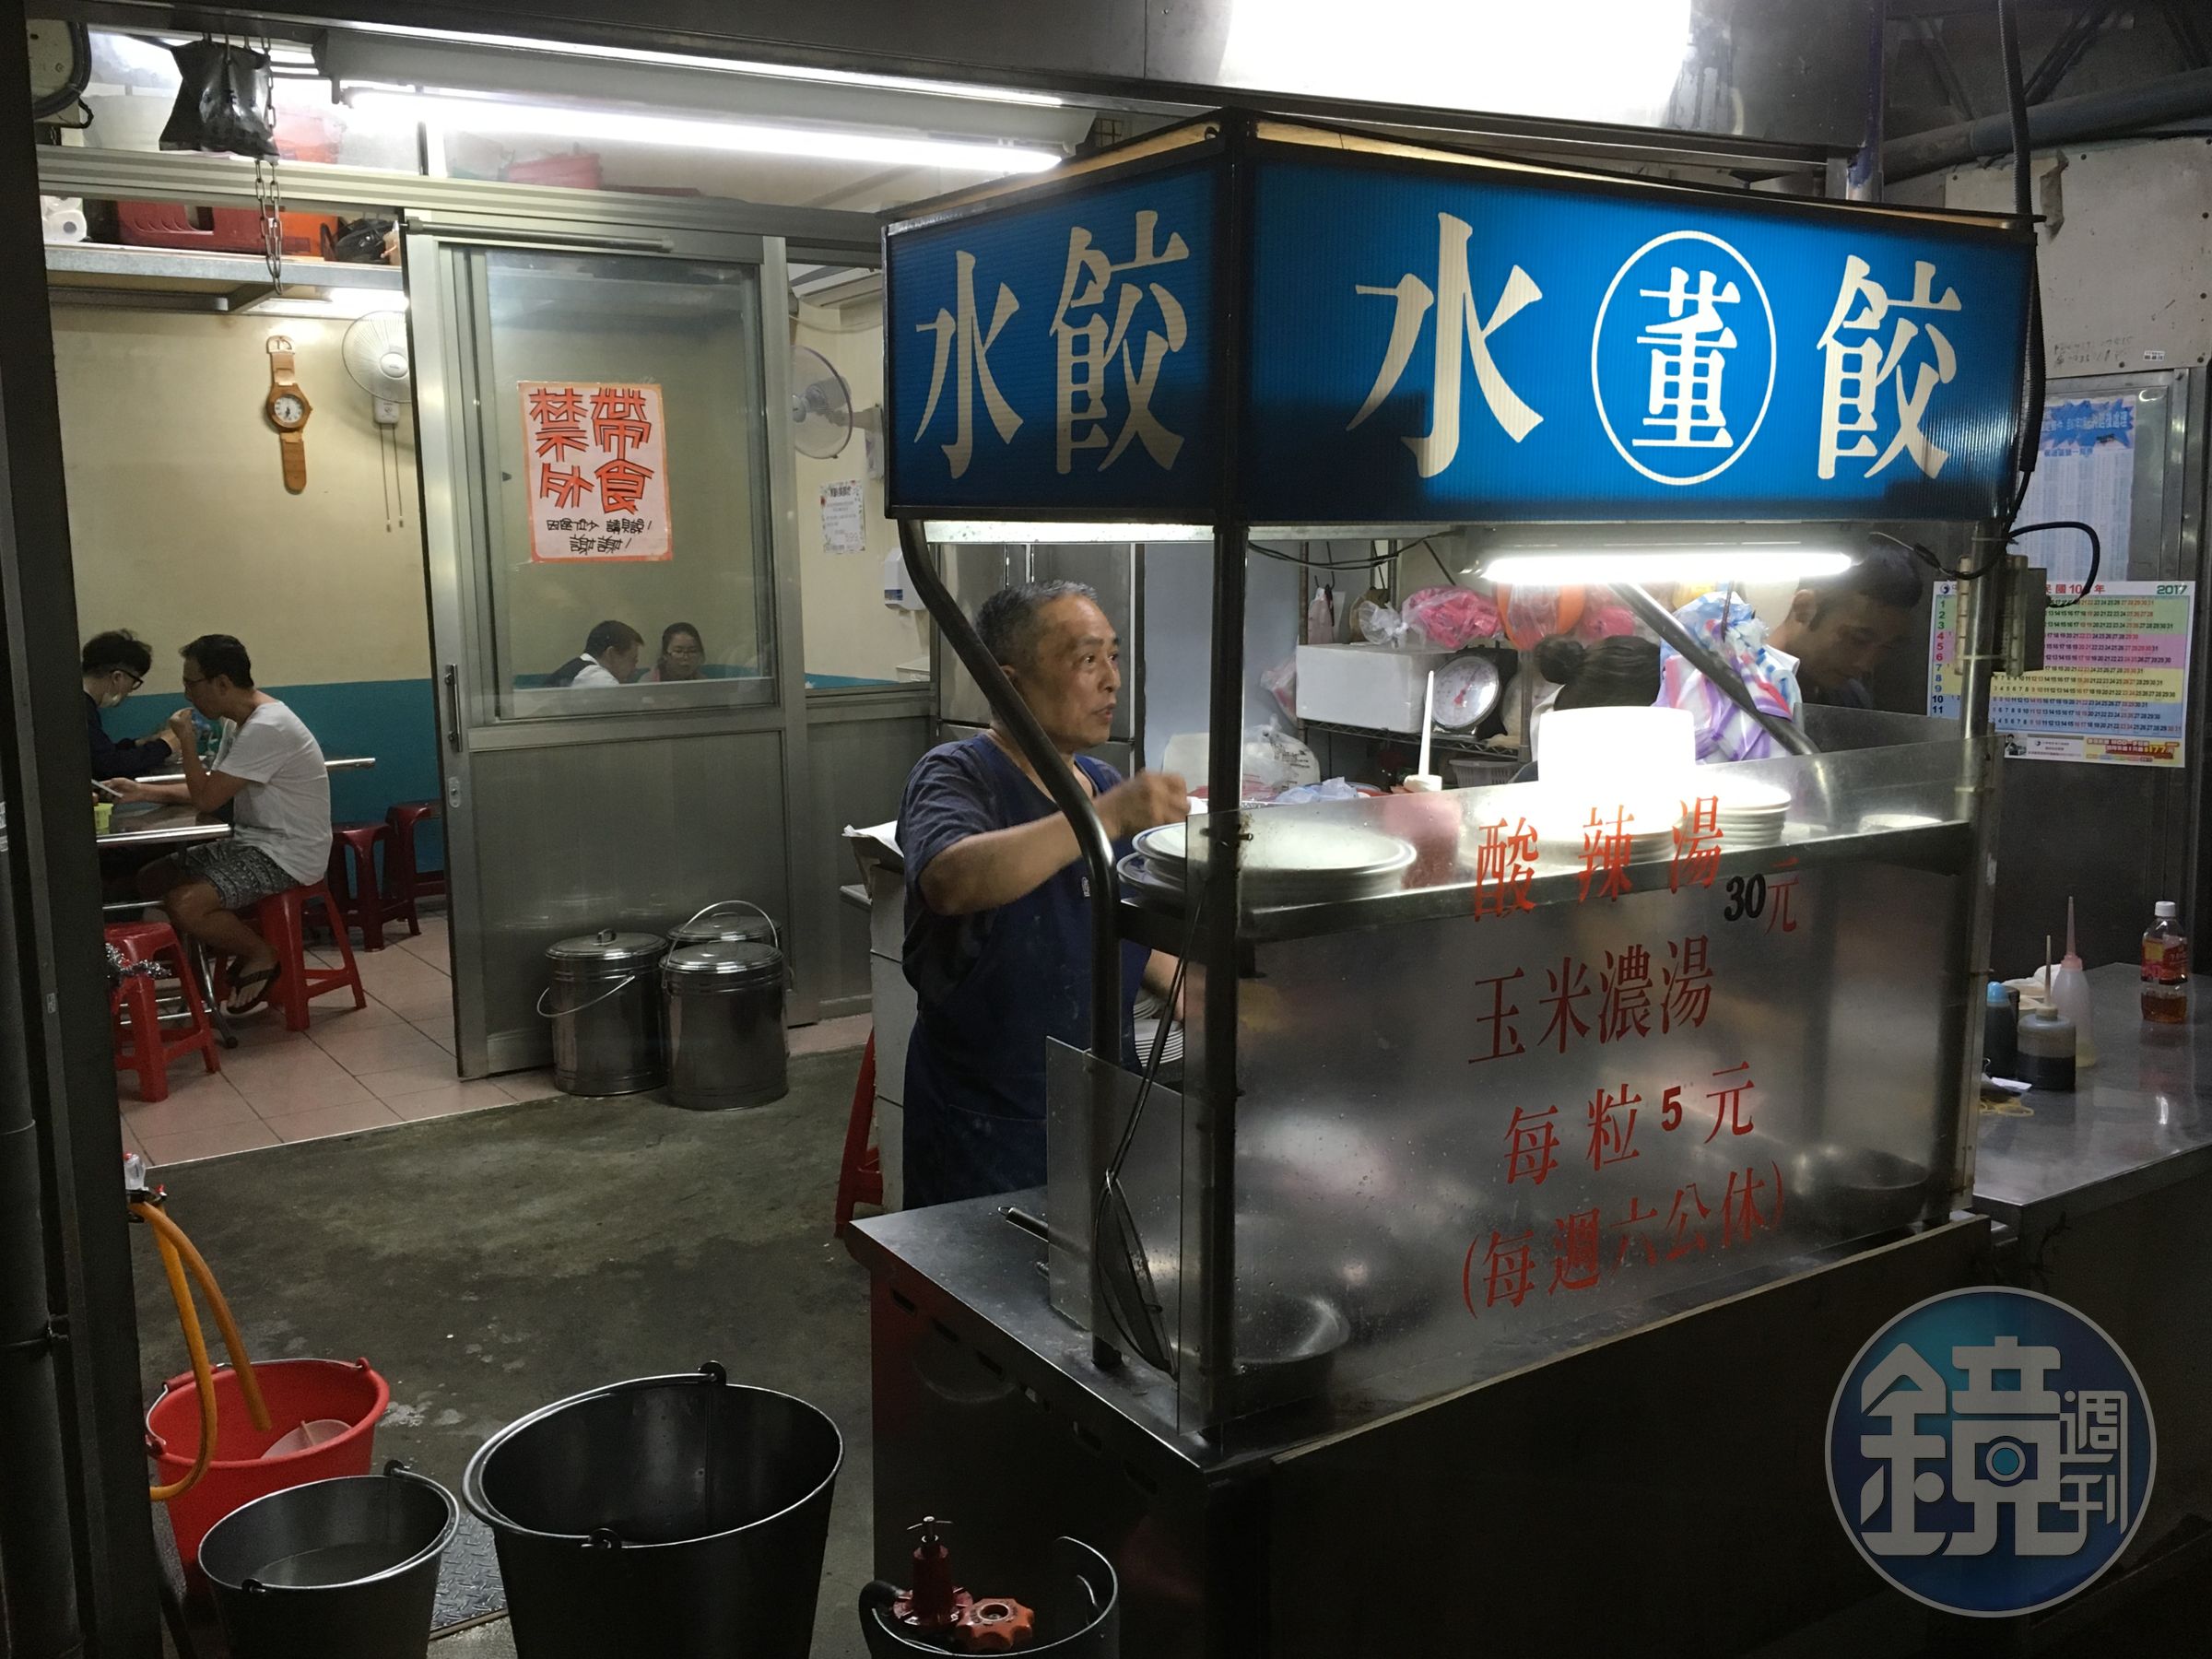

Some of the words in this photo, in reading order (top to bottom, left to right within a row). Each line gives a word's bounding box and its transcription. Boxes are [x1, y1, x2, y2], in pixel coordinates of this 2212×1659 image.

[914, 210, 1190, 478] 水餃
[529, 388, 652, 462] 禁帶
[540, 459, 655, 515] 外食
[2157, 585, 2188, 594] 2017
[1936, 642, 1944, 650] 5
[1936, 653, 1944, 661] 6
[1937, 632, 1944, 640] 4
[1932, 706, 1944, 714] 11
[1935, 684, 1942, 693] 9
[1473, 794, 1724, 923] 酸辣湯
[1724, 856, 1800, 936] 30元
[1467, 934, 1715, 1066] 玉米濃湯
[1503, 1061, 1755, 1186] 每粒5元
[1461, 1159, 1785, 1320] (每週六公休)
